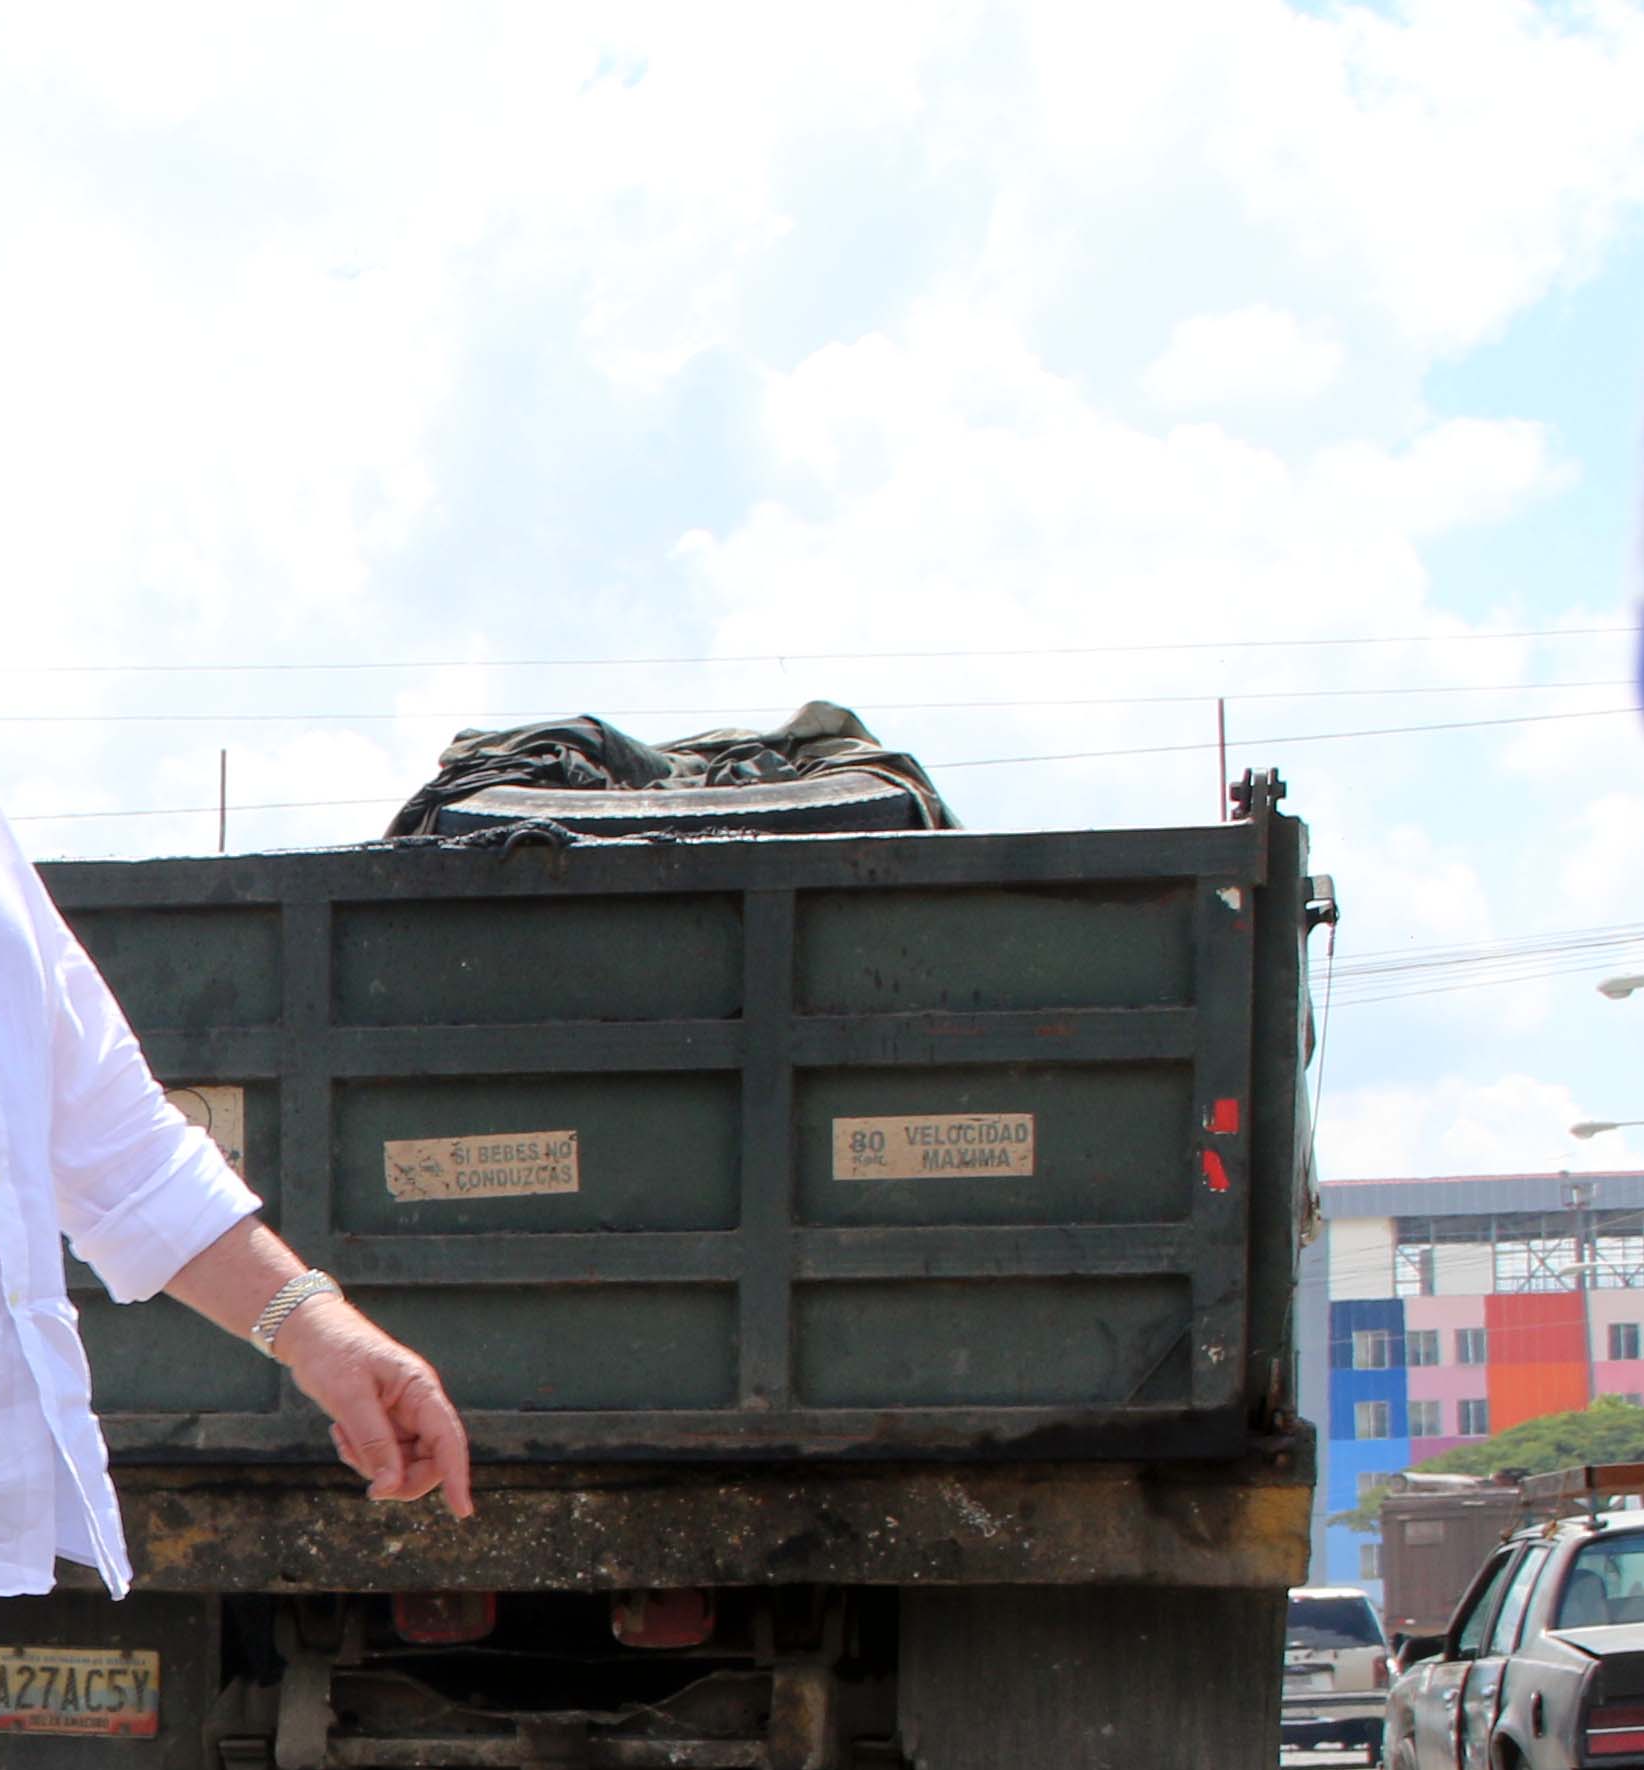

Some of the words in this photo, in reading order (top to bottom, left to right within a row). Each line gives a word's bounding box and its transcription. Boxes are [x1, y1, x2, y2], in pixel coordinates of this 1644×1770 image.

[850, 1130, 885, 1152] 80
[904, 1122, 1028, 1146] VELOCIDAD
[454, 1146, 471, 1164] SI
[478, 1143, 539, 1164] BEBES
[546, 1141, 573, 1160] NO
[922, 1148, 1011, 1171] MAXIMA
[455, 1165, 573, 1190] CONDUZCAS
